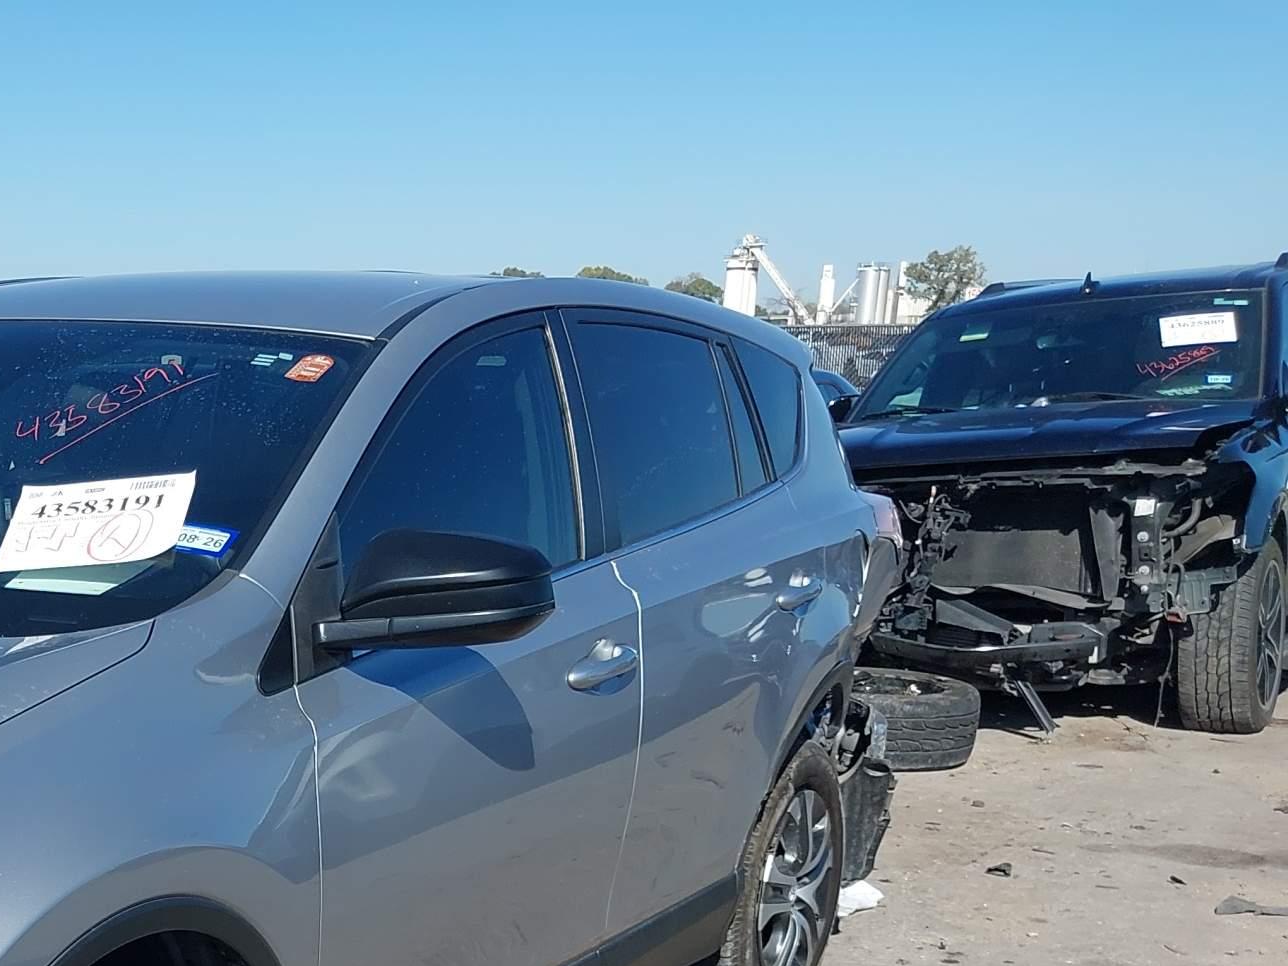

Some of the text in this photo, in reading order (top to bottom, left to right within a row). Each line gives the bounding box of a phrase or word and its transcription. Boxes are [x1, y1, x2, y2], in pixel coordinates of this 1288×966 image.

[15, 360, 185, 441] 43583191
[31, 493, 165, 519] 43583191
[201, 536, 225, 549] 26
